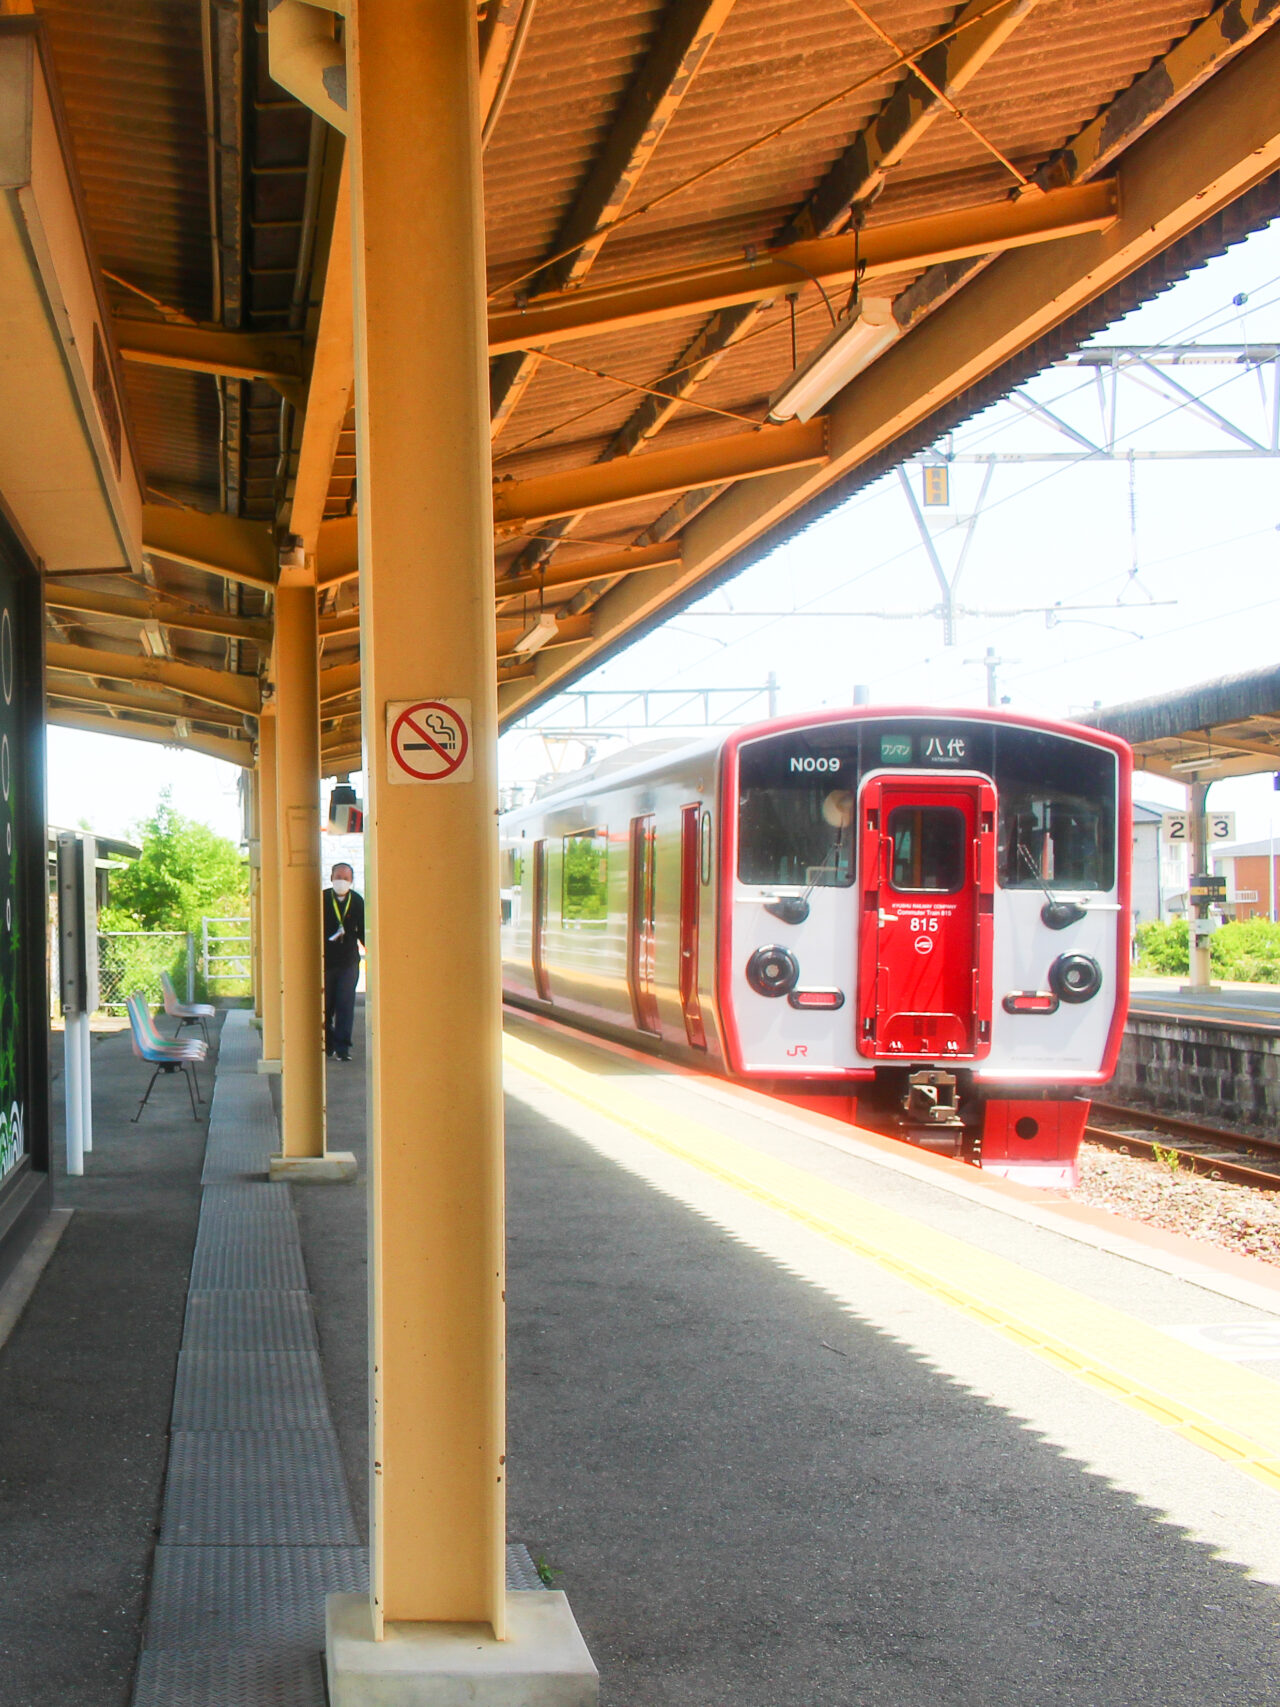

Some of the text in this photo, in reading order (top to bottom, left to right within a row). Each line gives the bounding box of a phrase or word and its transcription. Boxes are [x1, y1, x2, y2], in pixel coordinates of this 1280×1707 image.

[882, 744, 911, 756] ワンマン
[926, 737, 965, 757] 八代
[790, 756, 841, 773] N009
[1170, 821, 1185, 839] 2
[1213, 820, 1229, 838] 3
[910, 917, 938, 932] 815
[786, 1045, 808, 1057] JR
